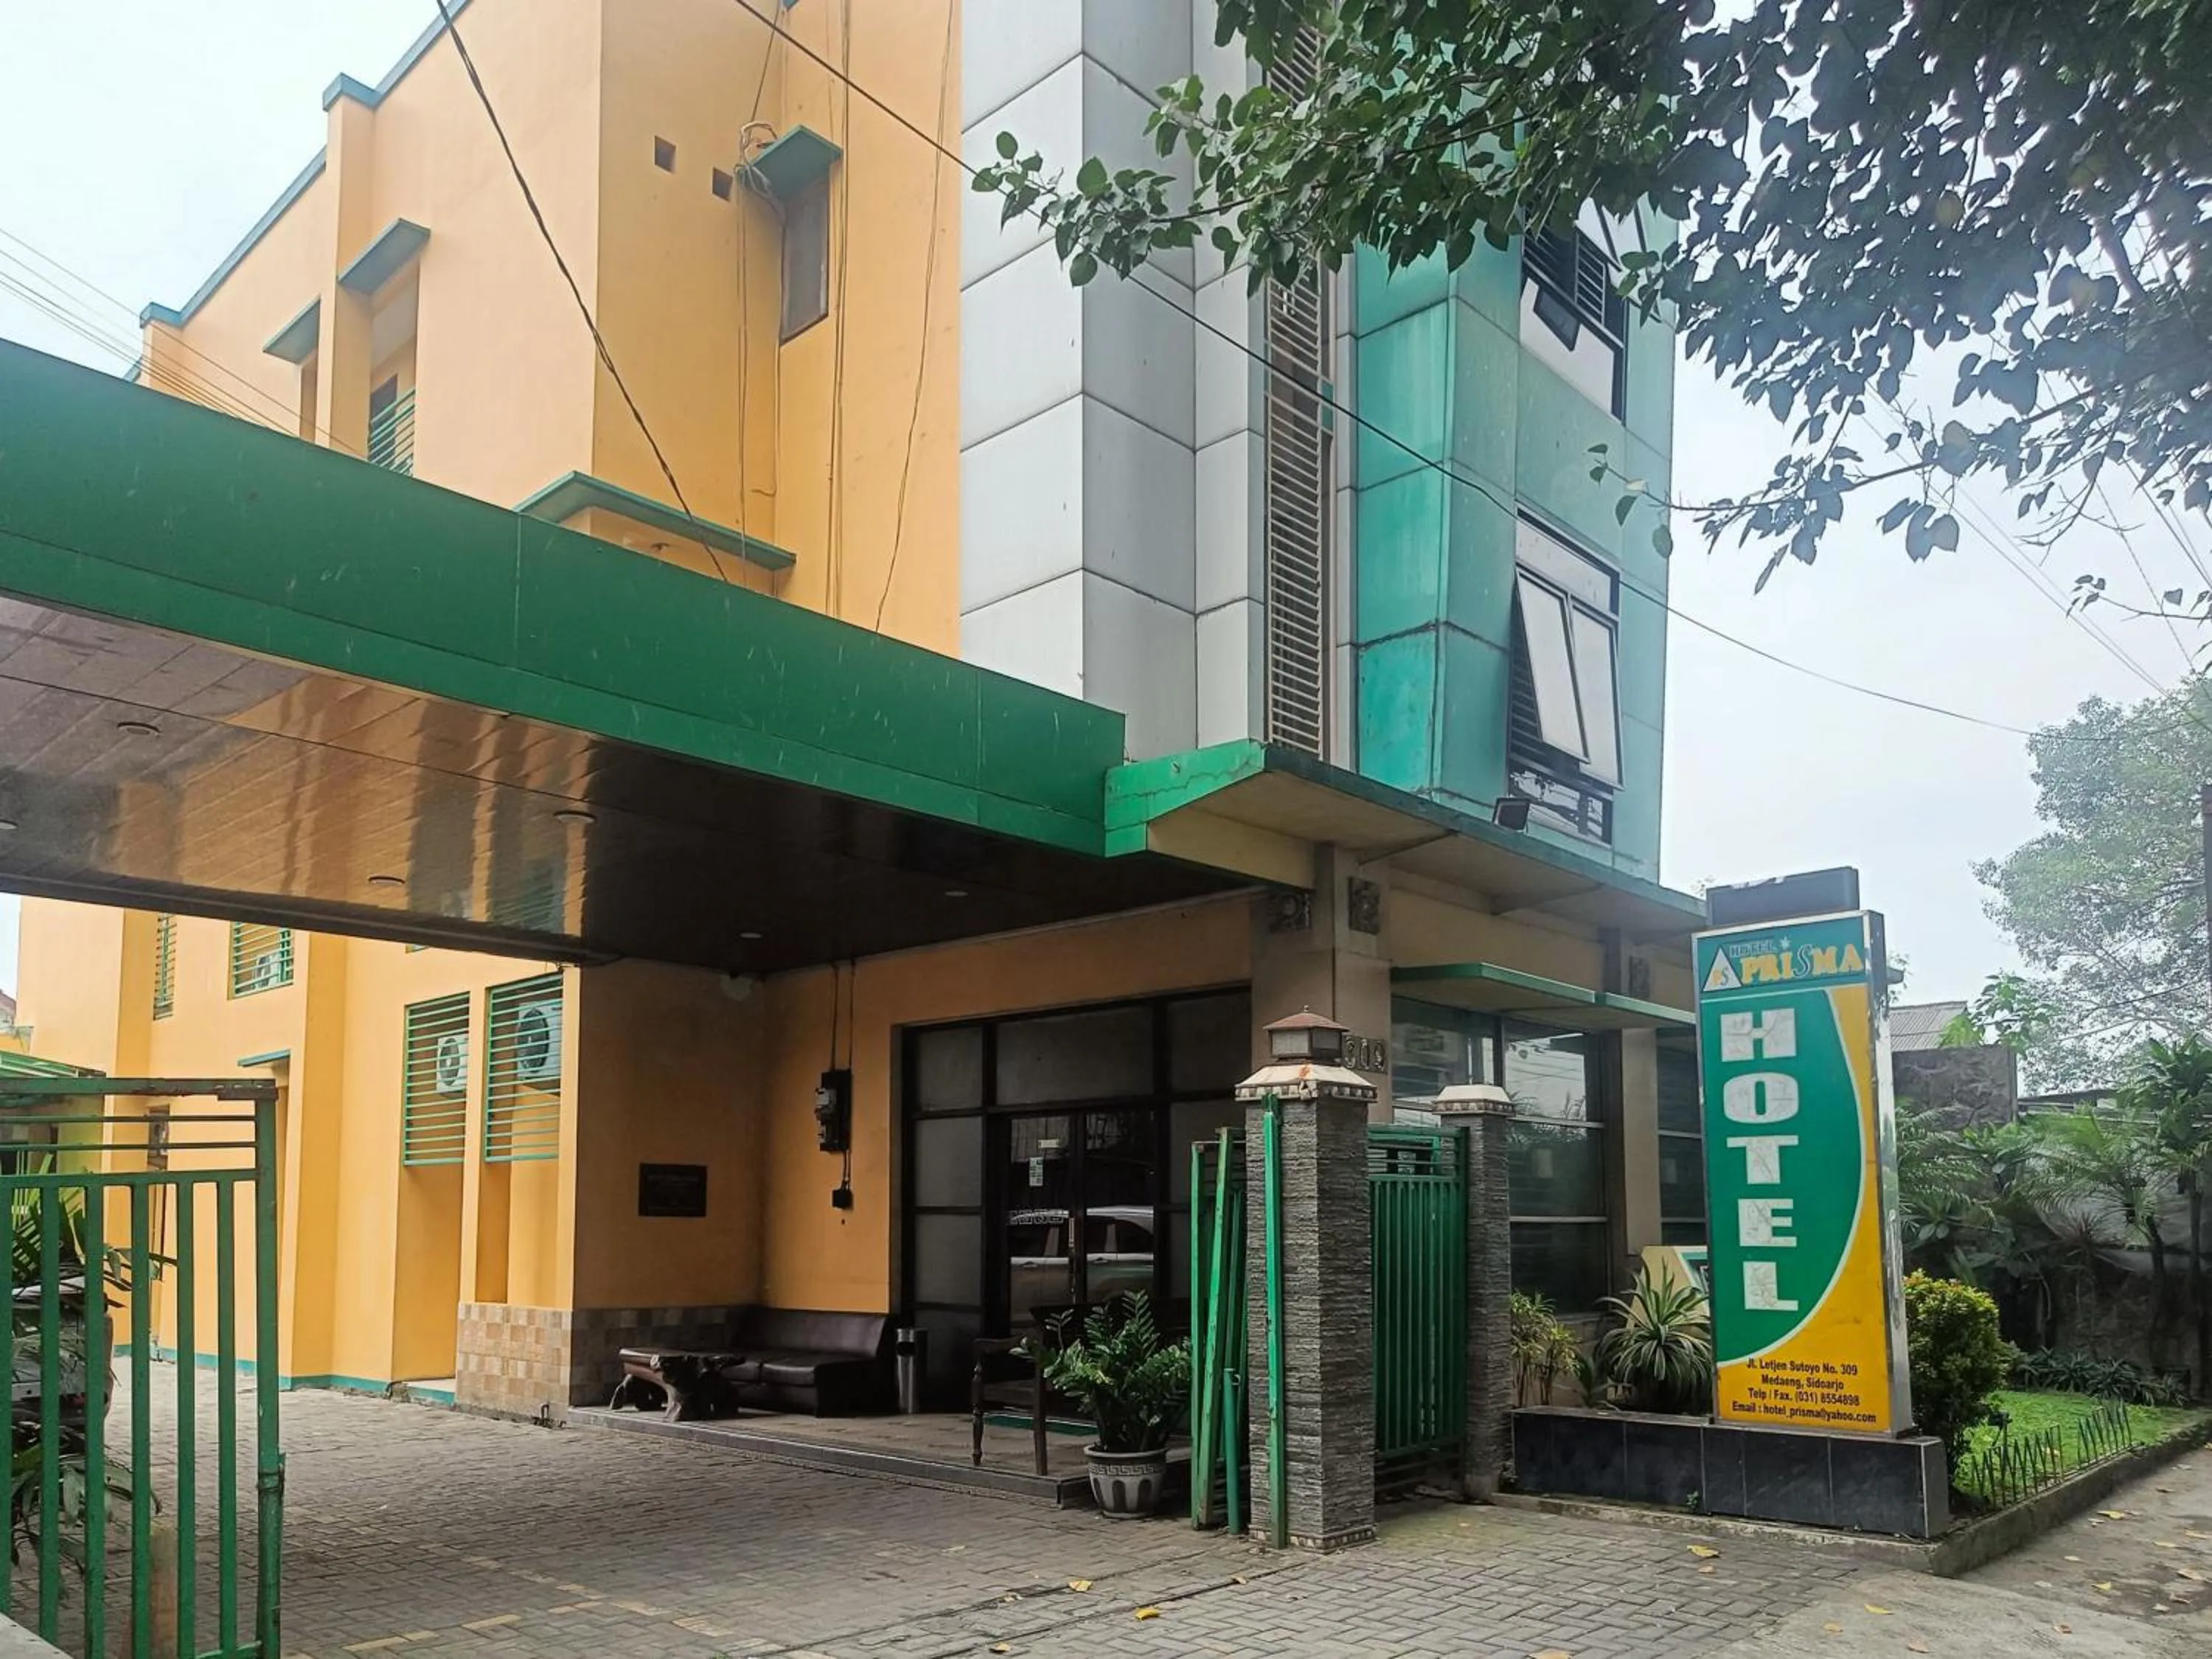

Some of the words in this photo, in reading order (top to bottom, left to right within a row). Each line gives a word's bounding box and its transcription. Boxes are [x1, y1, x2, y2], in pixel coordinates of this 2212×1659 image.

[1720, 1008, 1799, 1310] HOTEL
[1747, 1357, 1757, 1368] Jl.
[1760, 1357, 1787, 1372] Letjen
[1790, 1361, 1820, 1375] Sutoyo
[1823, 1363, 1837, 1374] No.
[1840, 1364, 1857, 1376] 309
[1761, 1374, 1804, 1390] Medaeng,
[1806, 1377, 1844, 1392] Sidoarjo
[1747, 1388, 1767, 1401] Telp
[1774, 1390, 1793, 1402] Fax.
[1795, 1391, 1818, 1404] (031)
[1732, 1400, 1756, 1412] Email
